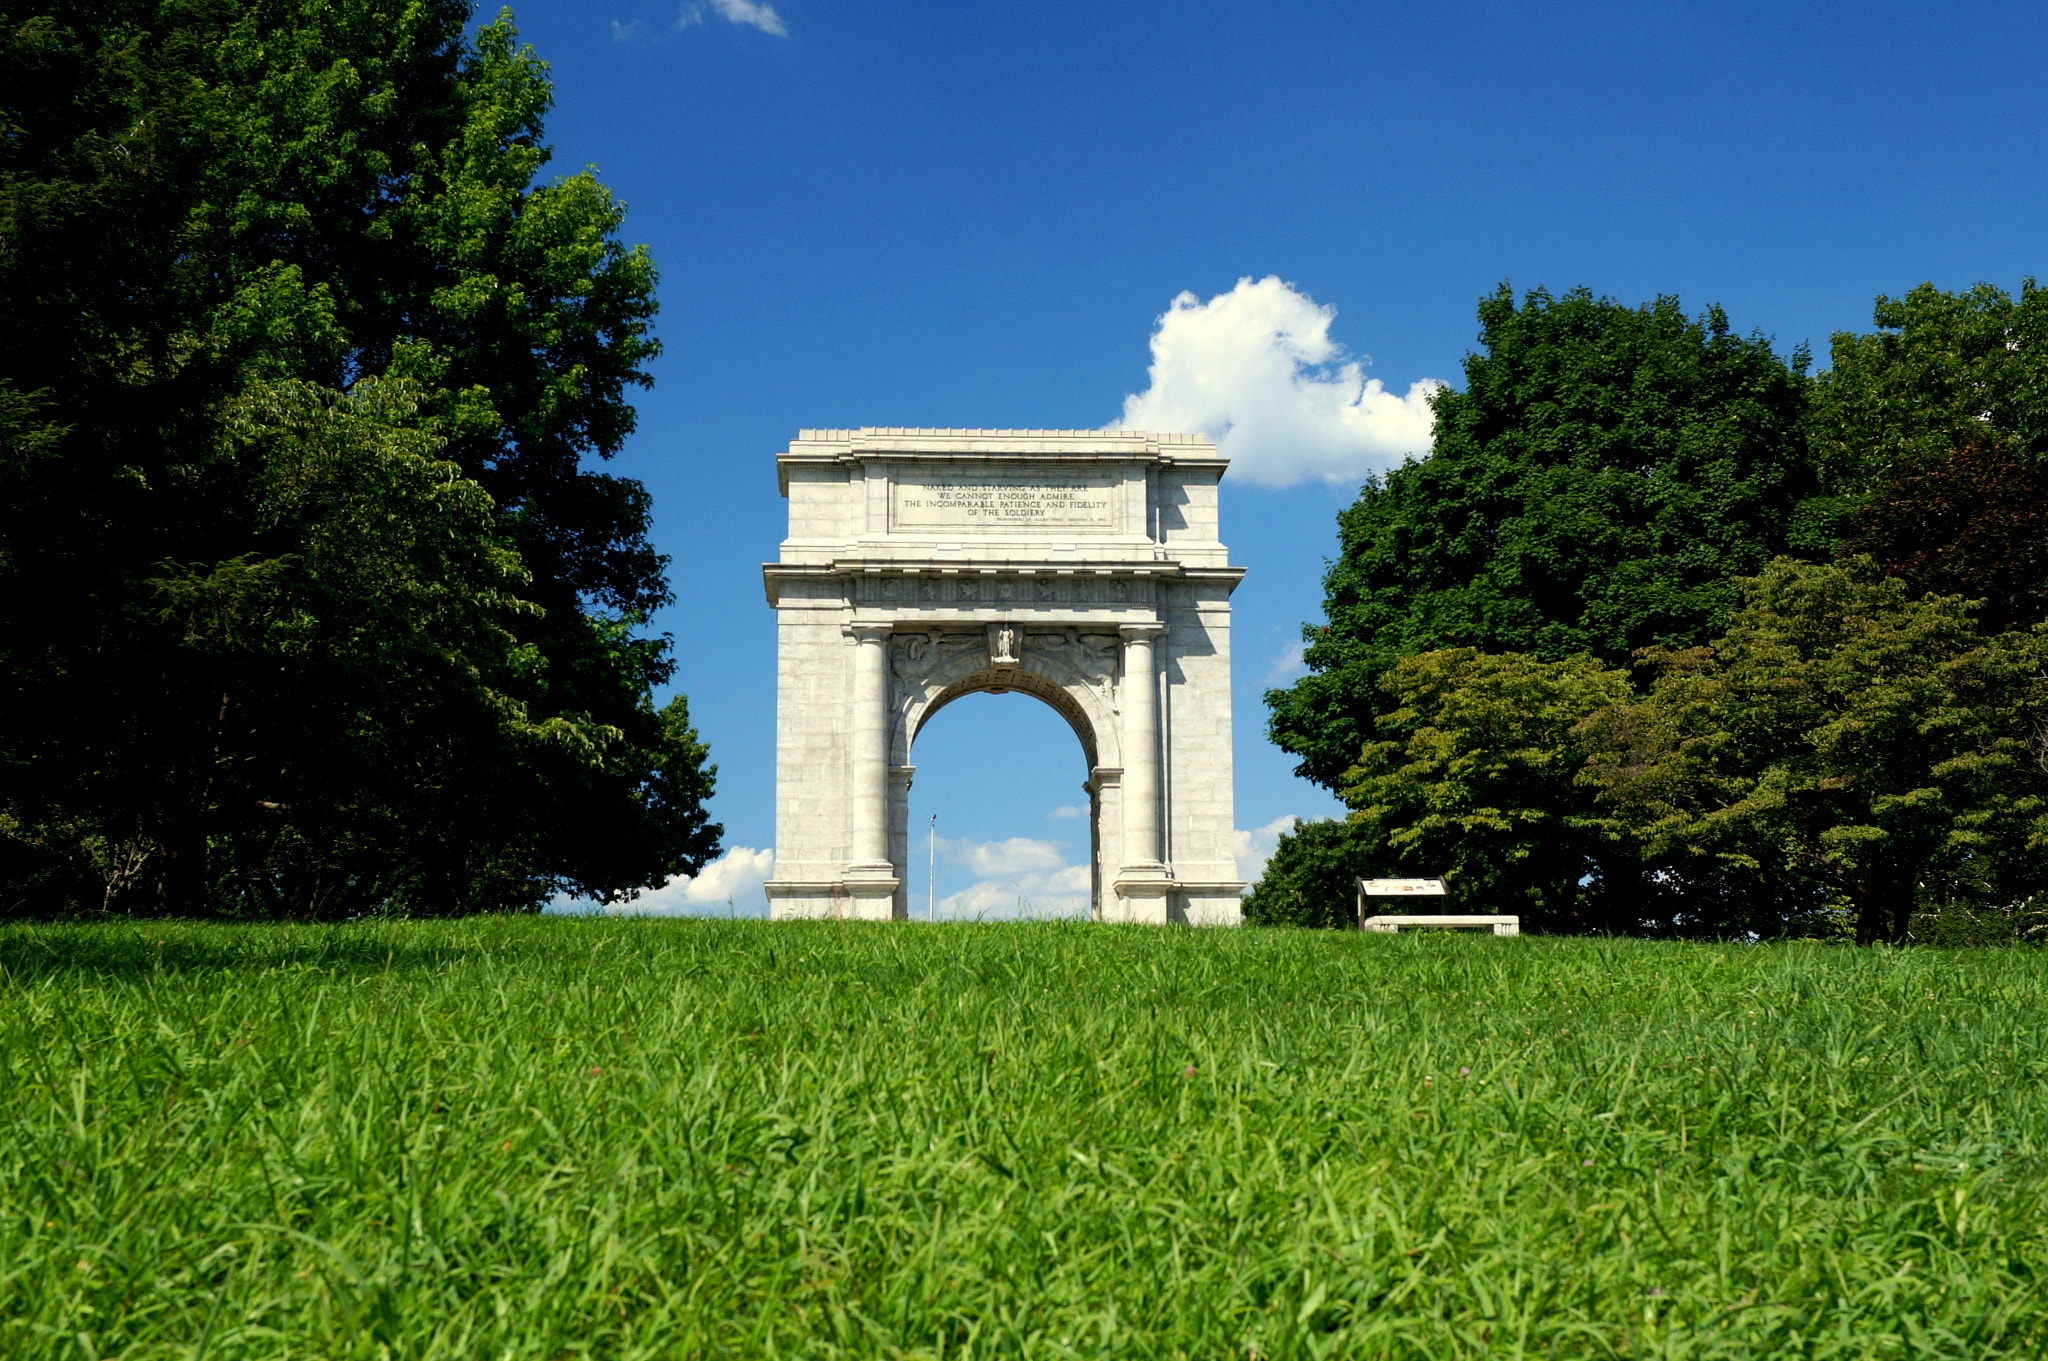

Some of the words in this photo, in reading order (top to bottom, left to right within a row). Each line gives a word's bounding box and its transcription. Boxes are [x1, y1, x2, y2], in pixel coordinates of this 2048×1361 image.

[922, 484, 954, 492] NAKED
[958, 484, 978, 492] AND
[982, 484, 1026, 492] STARVING
[1030, 484, 1041, 492] AS
[1044, 484, 1067, 492] THEY
[1071, 484, 1089, 492] ARE
[937, 492, 951, 500] WE
[955, 492, 993, 500] CANNOT
[998, 492, 1035, 500] ENOUGH
[904, 500, 922, 508] THE
[926, 500, 994, 508] INCOMPARABLE
[1045, 501, 1065, 509] AND
[1069, 501, 1107, 509] FIDELITY
[1005, 509, 1045, 517] SOLDIERY
